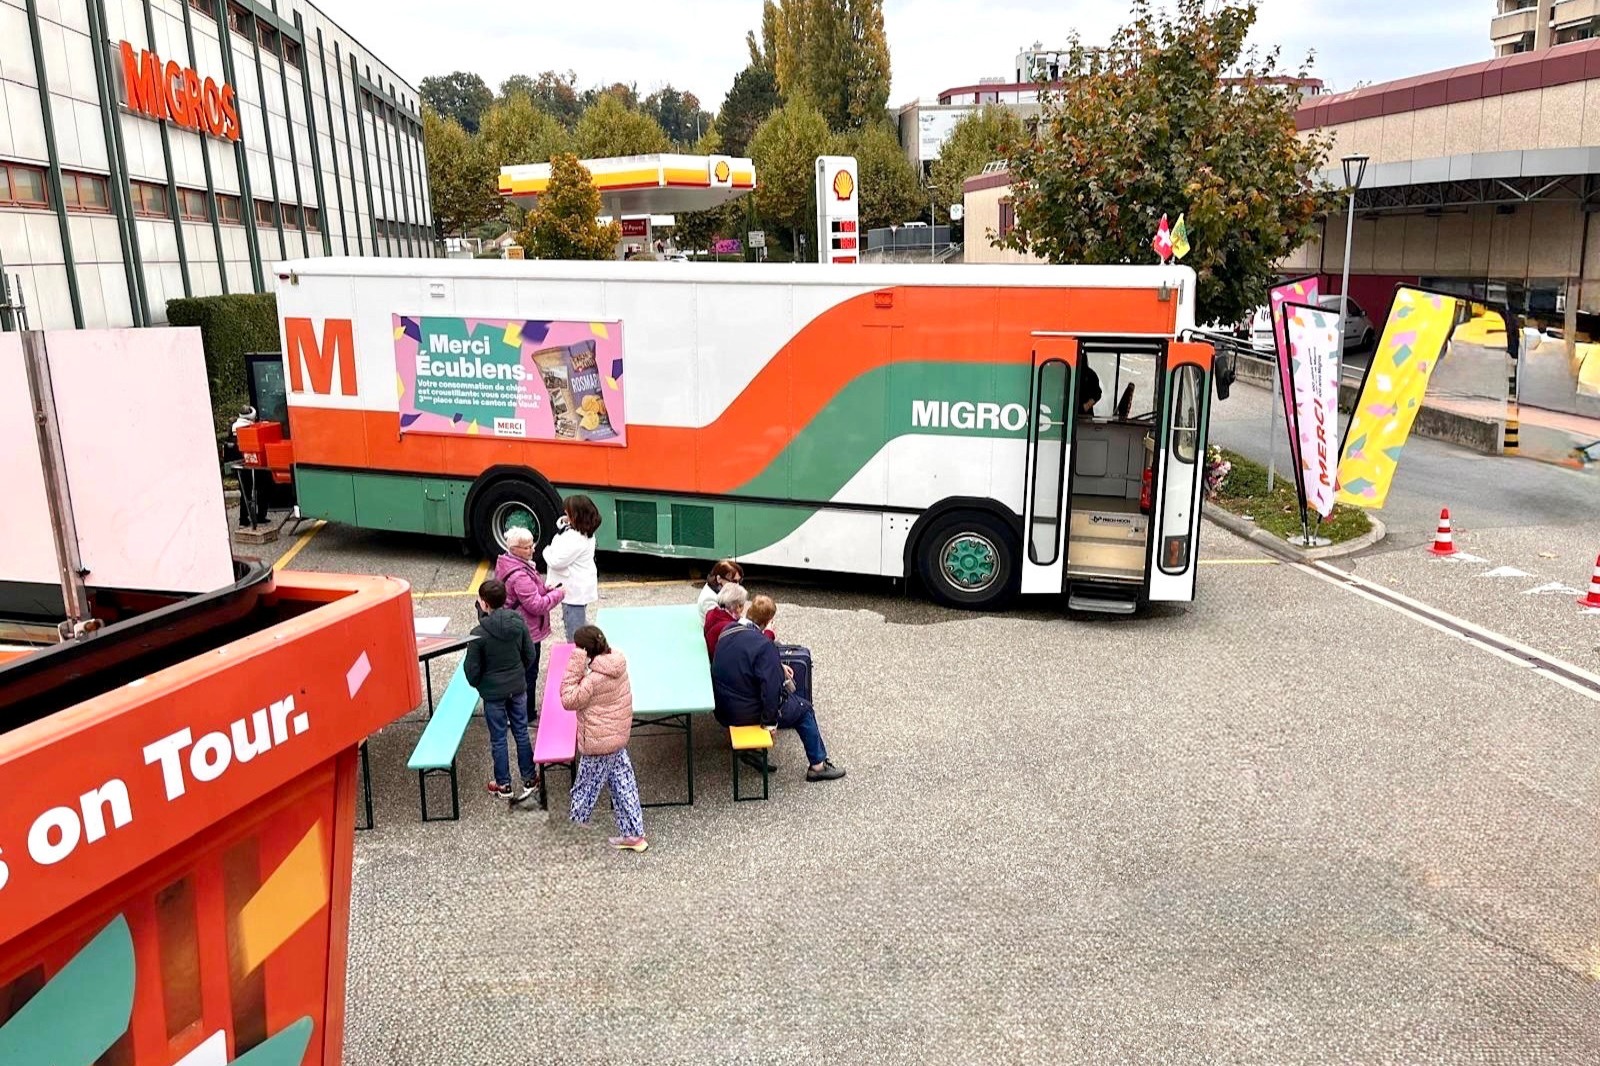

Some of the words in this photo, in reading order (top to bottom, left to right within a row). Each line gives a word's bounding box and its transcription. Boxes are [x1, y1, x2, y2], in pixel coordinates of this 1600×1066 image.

[118, 40, 240, 142] MIGROS
[284, 317, 358, 396] M
[429, 334, 490, 355] Merci
[416, 351, 533, 380] Écublens.
[417, 379, 437, 388] Votre
[438, 381, 493, 391] consommation
[494, 382, 504, 391] de
[506, 383, 527, 393] chips
[431, 388, 480, 397] croustillante:
[500, 393, 532, 402] occupez
[533, 393, 541, 401] le
[433, 396, 453, 405] place
[454, 397, 472, 405] dans
[473, 397, 480, 405] le
[480, 398, 506, 407] canton
[507, 398, 517, 407] de
[518, 399, 540, 408] Vaud.
[497, 422, 522, 430] MERCI
[1313, 398, 1330, 486] MERCI
[27, 777, 133, 866] on
[142, 694, 309, 801] Tour.
